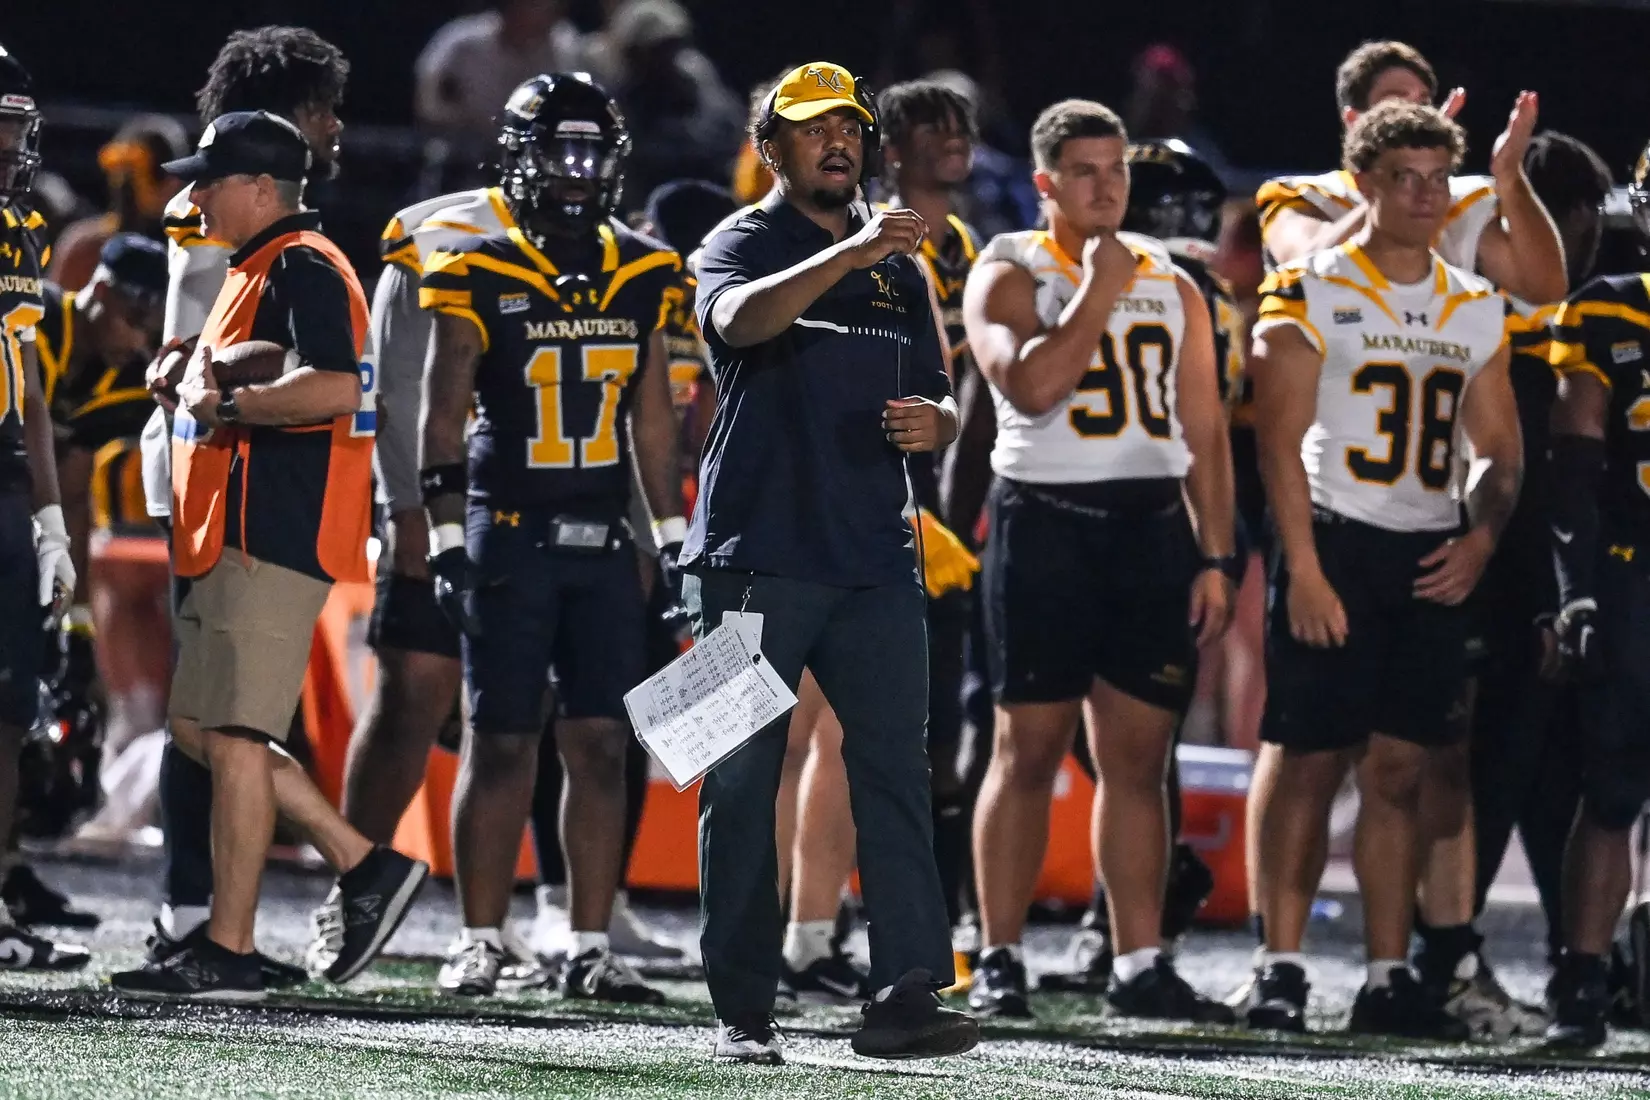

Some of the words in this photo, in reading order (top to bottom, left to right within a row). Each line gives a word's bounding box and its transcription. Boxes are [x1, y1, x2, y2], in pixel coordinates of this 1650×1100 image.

[524, 318, 639, 340] MARAUDERS
[1361, 331, 1472, 363] MARAUDERS
[524, 343, 640, 469] 17
[1345, 360, 1466, 492] 38
